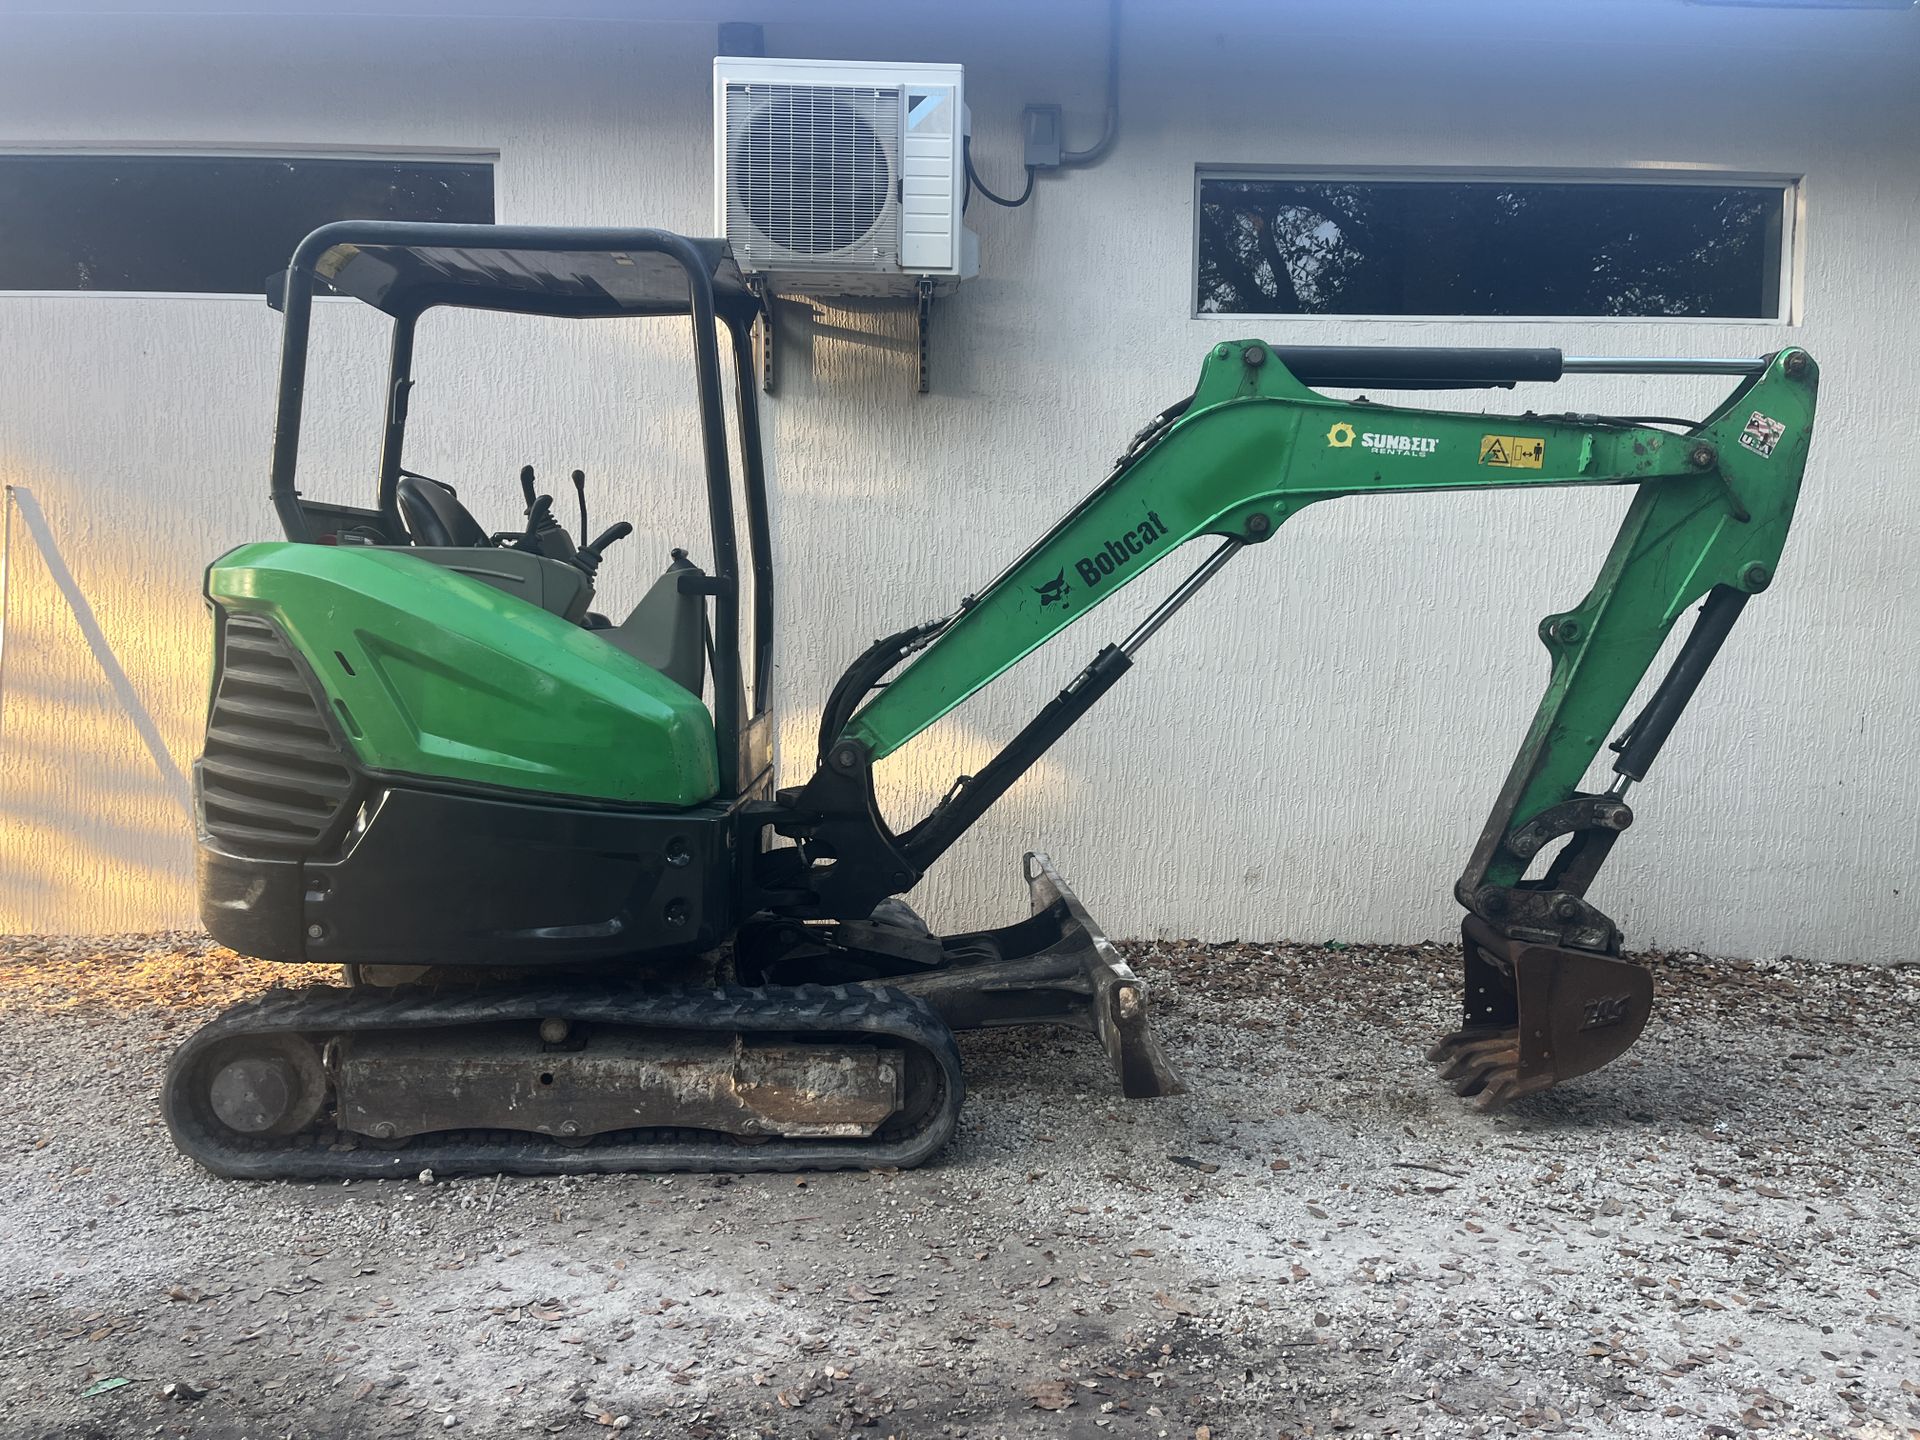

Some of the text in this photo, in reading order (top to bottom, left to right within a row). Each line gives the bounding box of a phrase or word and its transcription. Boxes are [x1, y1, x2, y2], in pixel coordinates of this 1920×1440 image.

[1361, 432, 1439, 452] SUNBELT
[1371, 448, 1427, 457] RENTALS
[1074, 510, 1168, 588] Bobcat
